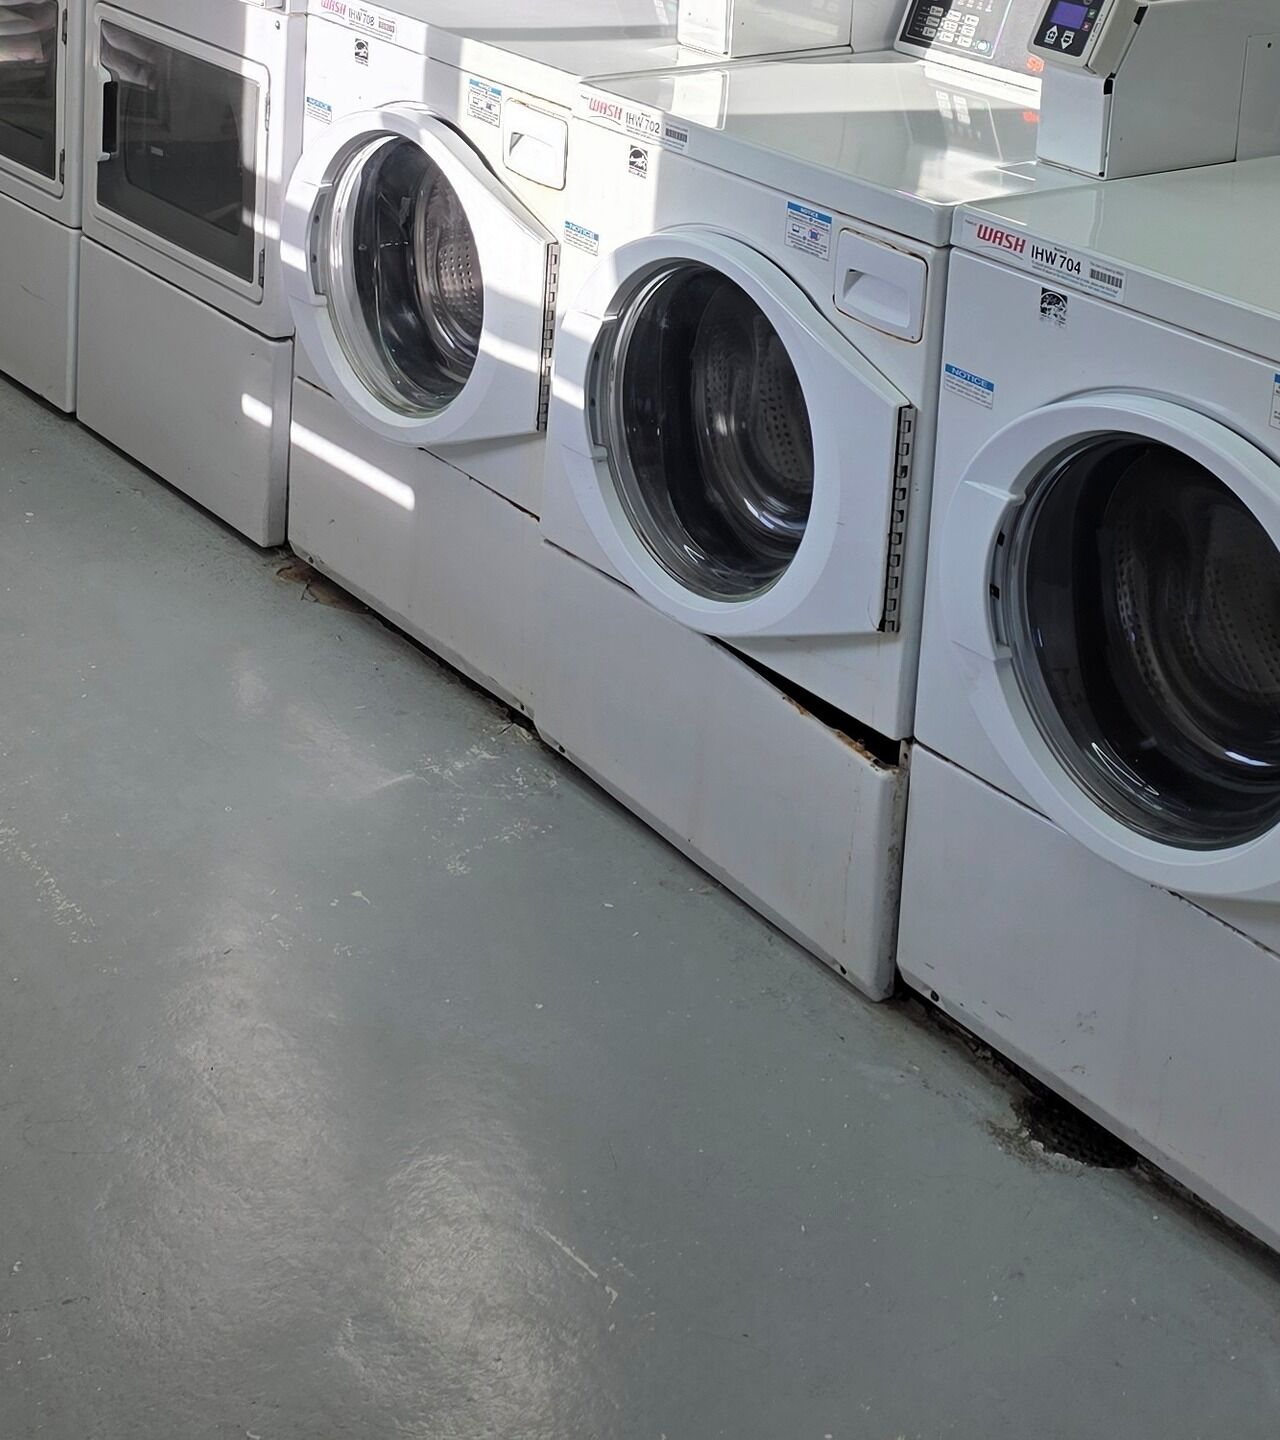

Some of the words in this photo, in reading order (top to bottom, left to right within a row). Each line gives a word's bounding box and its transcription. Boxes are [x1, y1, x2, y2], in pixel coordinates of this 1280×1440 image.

[589, 98, 623, 120] WASH
[626, 112, 643, 128] IHW
[645, 119, 660, 134] 702
[976, 224, 1027, 254] WASH
[1031, 244, 1057, 265] IHW
[1059, 255, 1081, 275] 704
[951, 367, 988, 387] NOTICE
